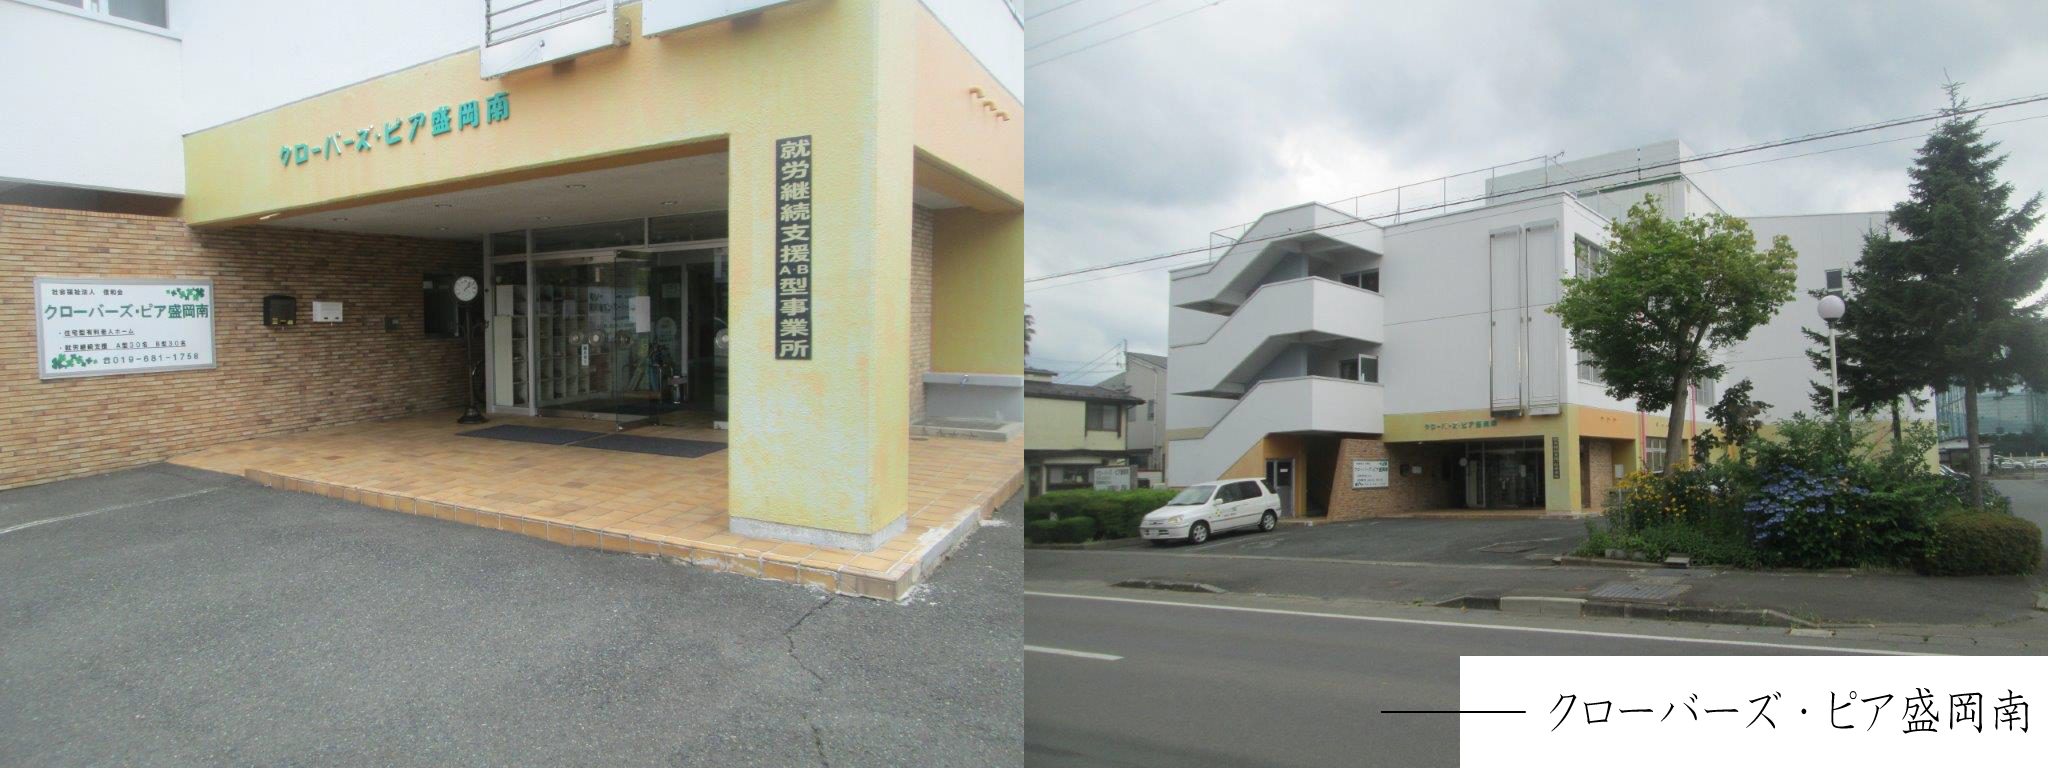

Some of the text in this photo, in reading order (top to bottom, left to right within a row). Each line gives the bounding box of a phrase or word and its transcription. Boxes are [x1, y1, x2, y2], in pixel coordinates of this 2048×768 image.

[280, 90, 511, 167] クローバーズ・ピア盛岡南
[44, 303, 209, 320] クローバーズ・ピア盛岡南
